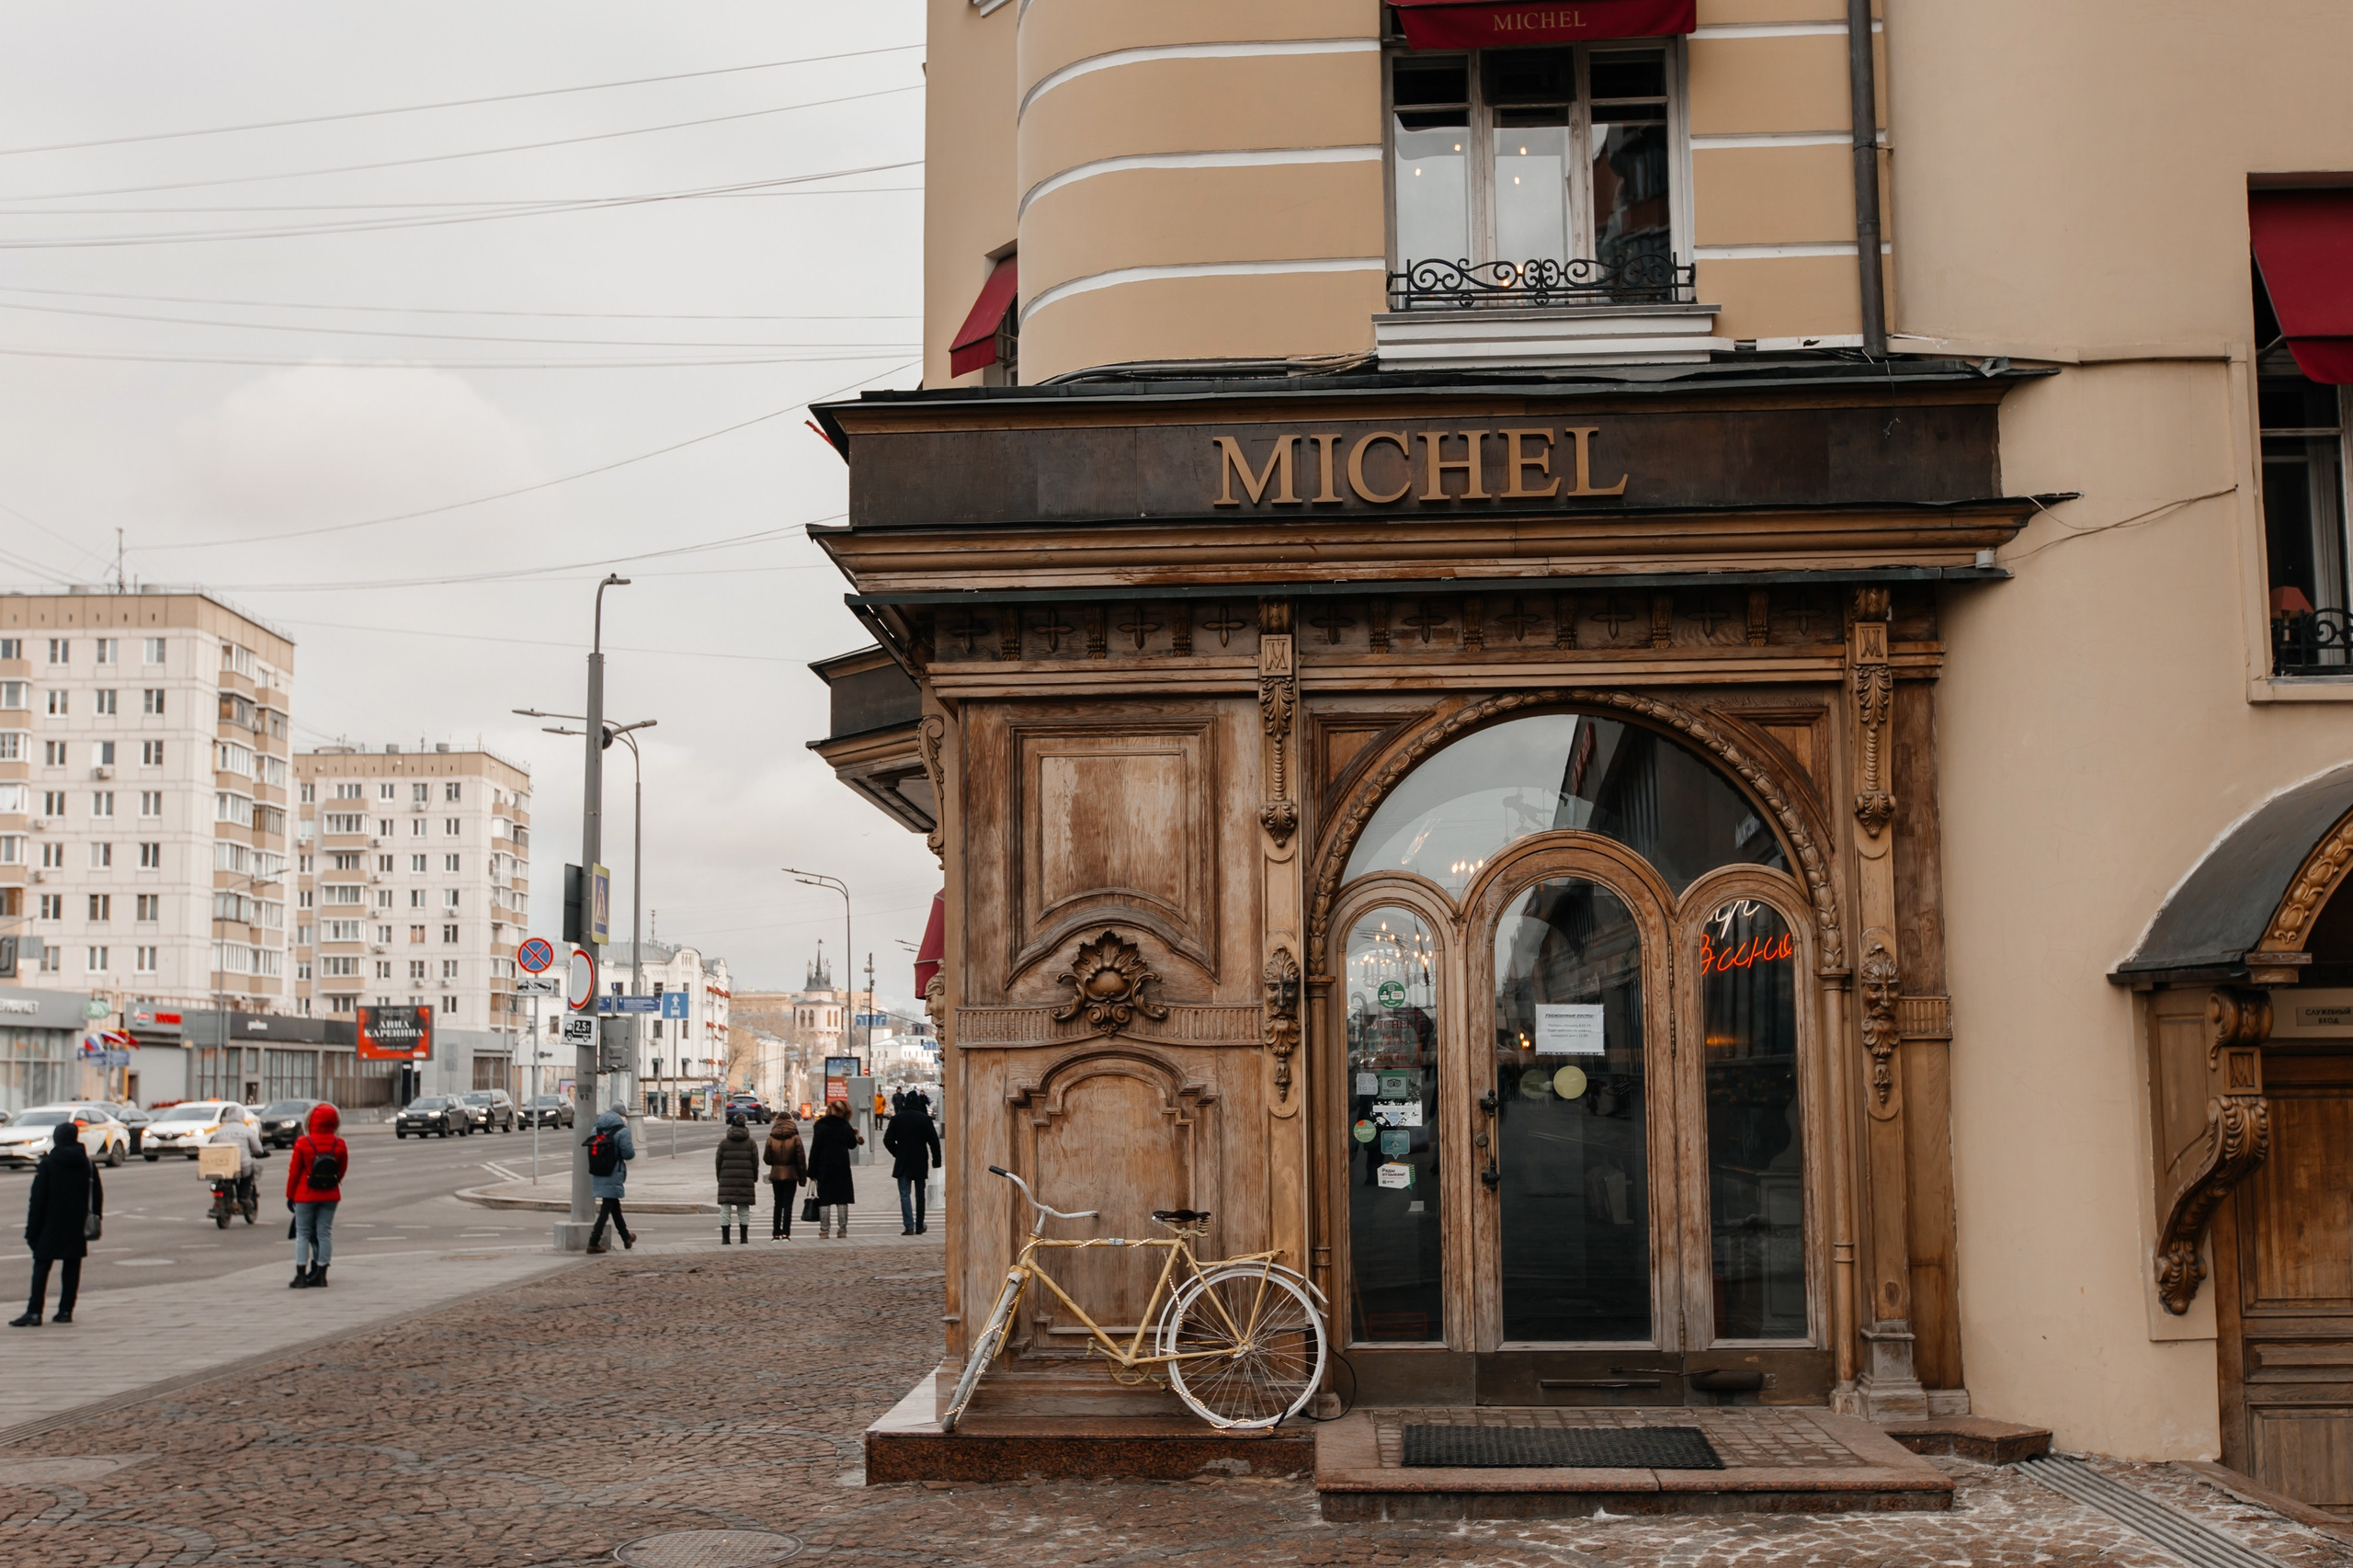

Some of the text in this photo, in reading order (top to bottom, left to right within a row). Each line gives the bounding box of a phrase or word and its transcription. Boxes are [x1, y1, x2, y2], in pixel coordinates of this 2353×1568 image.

[1493, 11, 1586, 31] MICHEL
[1212, 426, 1629, 506] MICHEL
[1861, 629, 1883, 657] M
[2305, 1007, 2351, 1016] СЛУЖЕБНЫЙ
[379, 1020, 410, 1029] АННА
[1370, 1019, 1412, 1028] MICHEL
[364, 1028, 424, 1038] КАРЕНИНА
